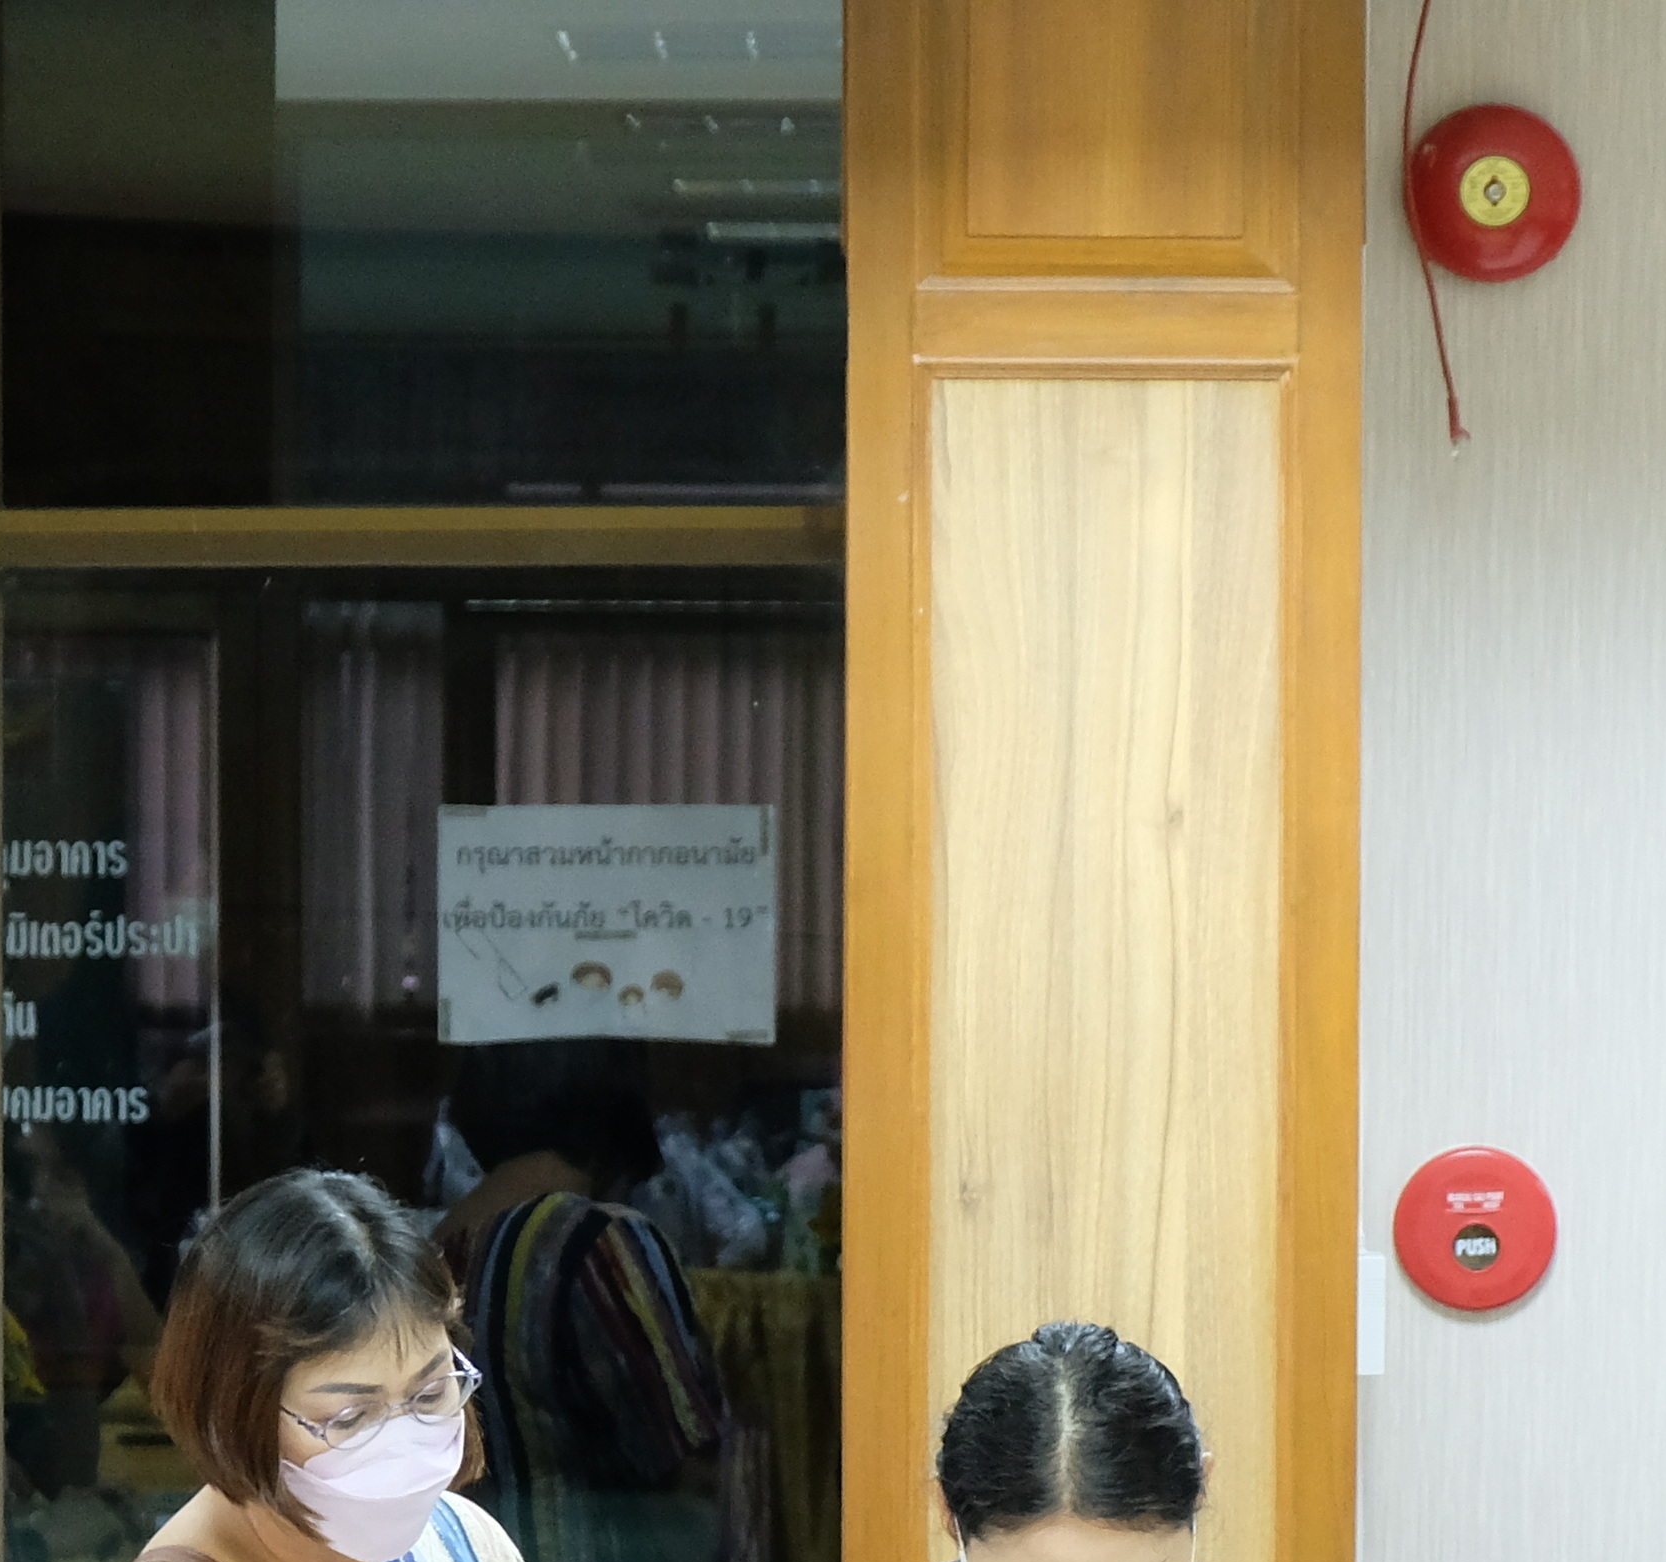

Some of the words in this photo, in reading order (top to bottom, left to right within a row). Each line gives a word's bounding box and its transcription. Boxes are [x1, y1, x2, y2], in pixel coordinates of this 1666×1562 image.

[455, 835, 756, 875] กรุณาสวมหน้ากากอนามัย
[1454, 1236, 1497, 1257] PUSH
